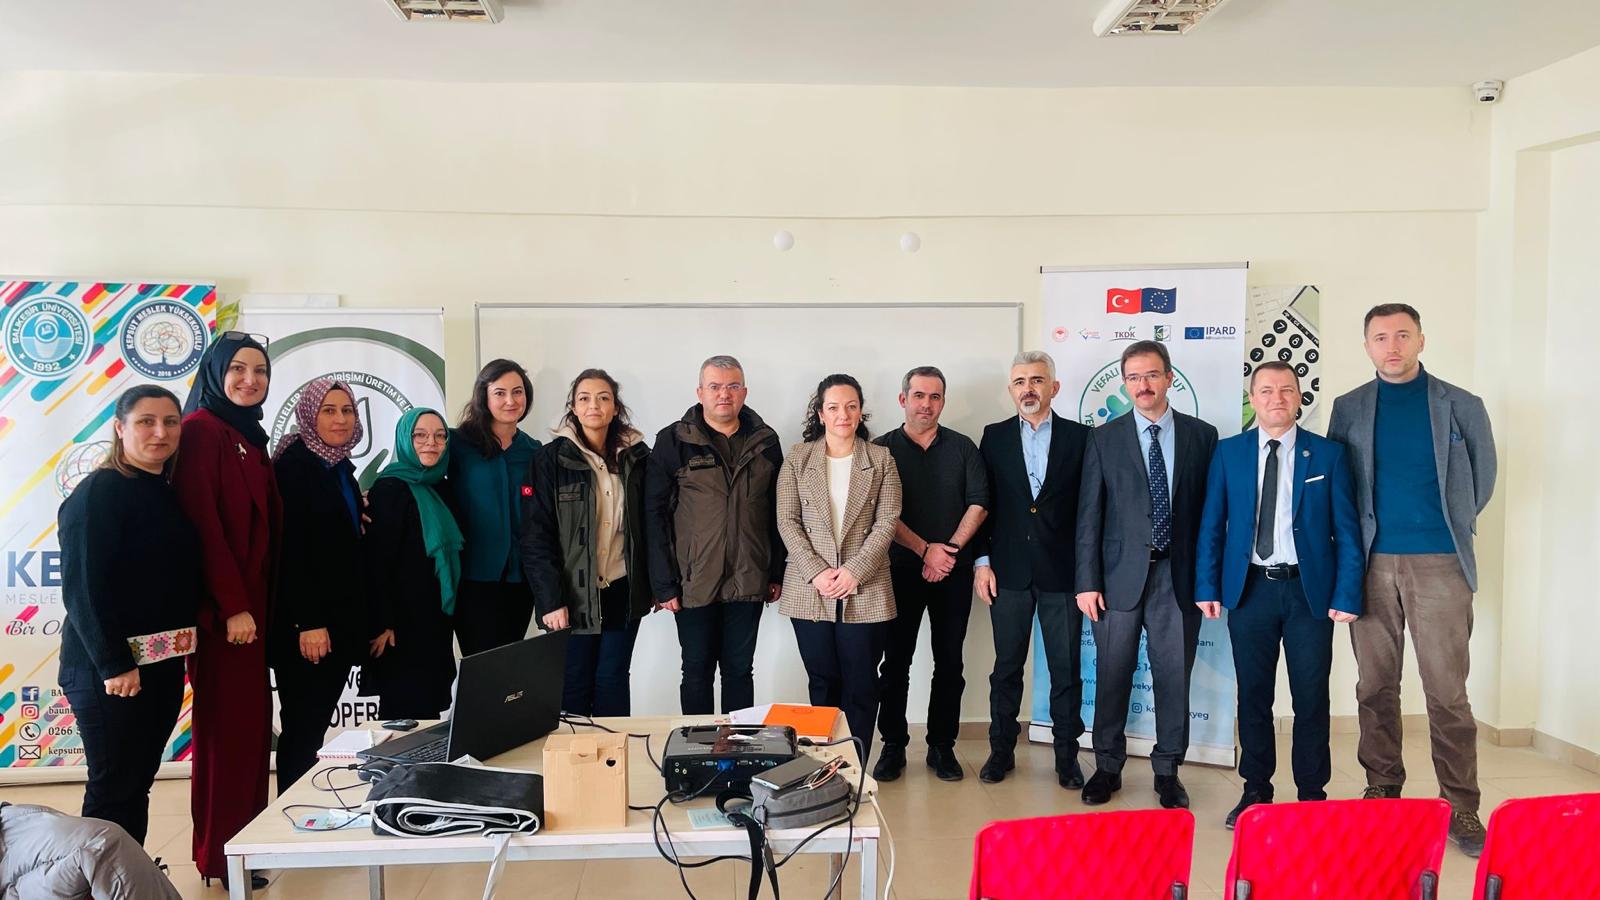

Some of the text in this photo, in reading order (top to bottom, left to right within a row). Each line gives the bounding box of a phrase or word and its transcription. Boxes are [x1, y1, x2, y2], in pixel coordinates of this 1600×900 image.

[12, 302, 84, 345] BALIKESİR ÜNİVERSİTESİ
[125, 304, 203, 351] KEPSUT MESLEK YÜKSEKOKULU
[1206, 326, 1236, 335] IPARD
[32, 361, 61, 372] 1992
[1091, 367, 1120, 393] VEFALI
[365, 375, 398, 398] ÜRETİM
[396, 394, 407, 408] VE
[10, 620, 35, 635] Bir
[48, 726, 73, 736] 0266
